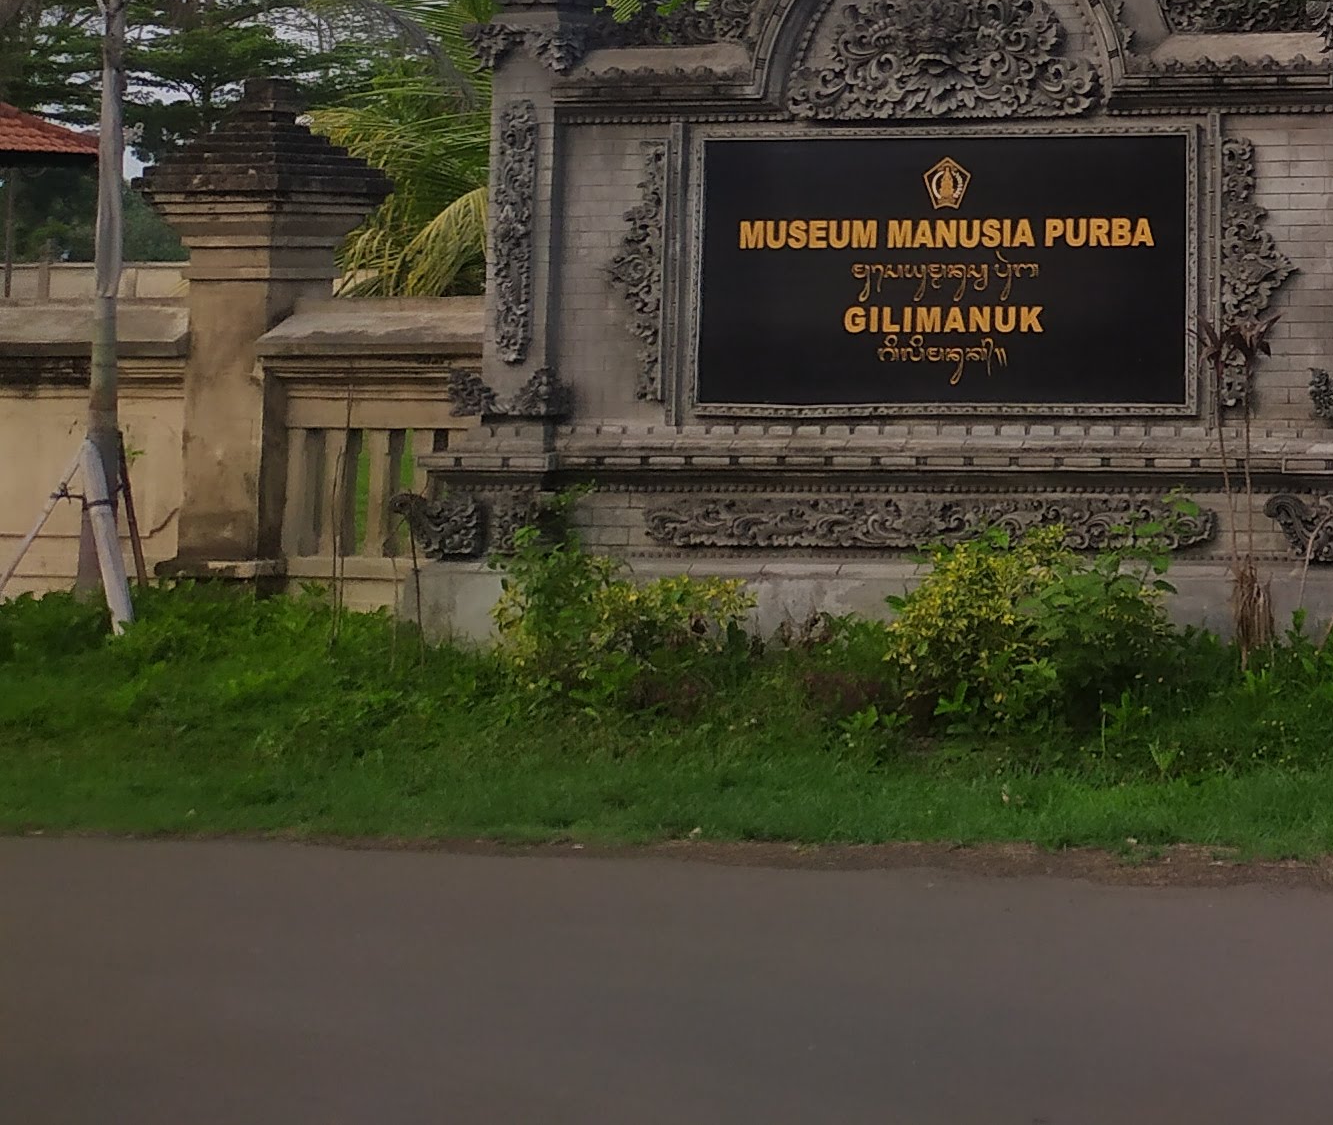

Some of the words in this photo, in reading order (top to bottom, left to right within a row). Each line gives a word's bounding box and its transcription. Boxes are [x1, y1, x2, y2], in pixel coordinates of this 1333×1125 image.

[739, 219, 877, 250] MUSEUM
[887, 218, 1035, 249] MANUSIA
[1044, 217, 1155, 248] PURBA
[843, 305, 1044, 334] GILIMANUK
